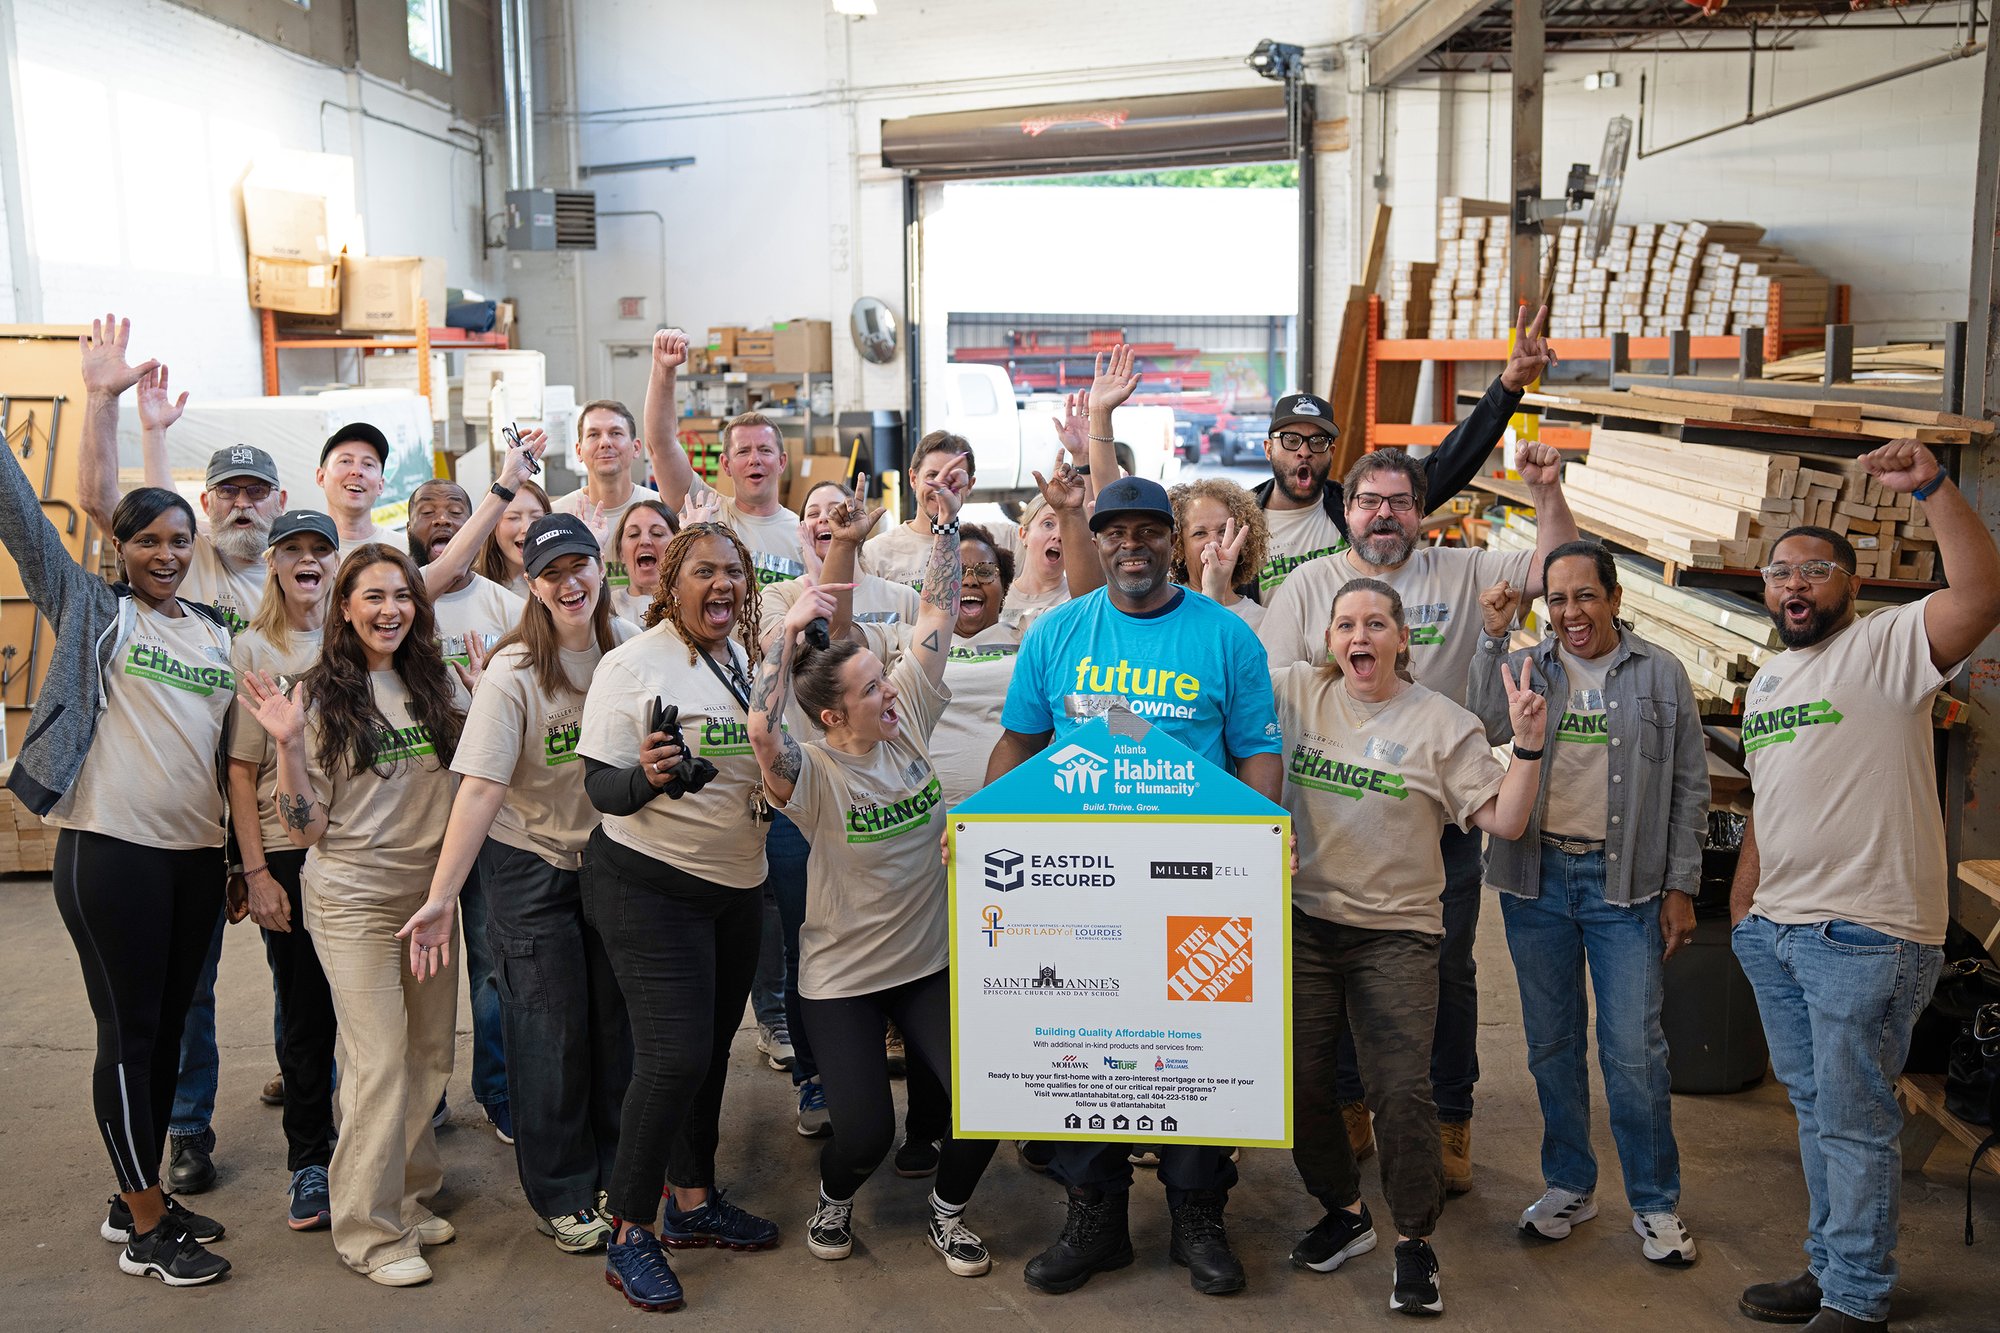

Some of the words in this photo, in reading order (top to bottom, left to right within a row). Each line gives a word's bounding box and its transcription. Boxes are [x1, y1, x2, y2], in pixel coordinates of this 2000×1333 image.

[1270, 552, 1285, 561] THE
[137, 642, 148, 650] BE
[152, 646, 168, 655] THE
[1075, 656, 1201, 701] future
[548, 708, 573, 720] MILLER
[706, 717, 718, 726] BE
[720, 717, 736, 725] THE
[1744, 704, 1820, 741] HANGE.
[548, 726, 560, 736] BE
[561, 721, 578, 732] THE
[1303, 732, 1326, 743] MILLER
[1328, 740, 1344, 749] ZELL
[1114, 744, 1147, 755] Atlanta
[1296, 744, 1306, 754] BE
[1308, 747, 1324, 759] THE
[1114, 759, 1195, 780] Habitat
[1292, 752, 1390, 795] CHANGE.
[1115, 782, 1132, 794] for
[858, 803, 877, 813] THE
[1137, 804, 1160, 812] Grow.
[1032, 855, 1114, 869] EASTDIL
[1156, 866, 1208, 875] MILLER
[1215, 866, 1248, 877] ZELL
[1031, 874, 1116, 887] SECURED
[1006, 928, 1031, 936] OUR
[1034, 928, 1063, 936] LADY
[1064, 928, 1073, 936] of
[1075, 929, 1122, 937] LOURDES
[1175, 925, 1211, 959] THE
[1168, 916, 1253, 1001] HOME
[1201, 948, 1253, 1001] DEPOT
[984, 978, 1030, 988] SAINT
[1065, 977, 1120, 989] ANNE'S
[1035, 1027, 1076, 1038] Building
[1078, 1028, 1113, 1039] Quality
[1115, 1029, 1165, 1039] Affordable
[1168, 1030, 1202, 1039] Homes
[1050, 1041, 1084, 1049] additional
[1110, 1043, 1139, 1051] products
[1186, 1044, 1204, 1052] from:
[988, 1072, 1010, 1080] Ready
[1021, 1073, 1035, 1081] buy
[1115, 1075, 1160, 1083] zero-interest
[1162, 1076, 1196, 1085] mortgage
[1047, 1082, 1077, 1090] qualifies
[1052, 1092, 1135, 1100] www.atlantahabitat.org,
[1110, 1101, 1166, 1109] @atlantahabitat
